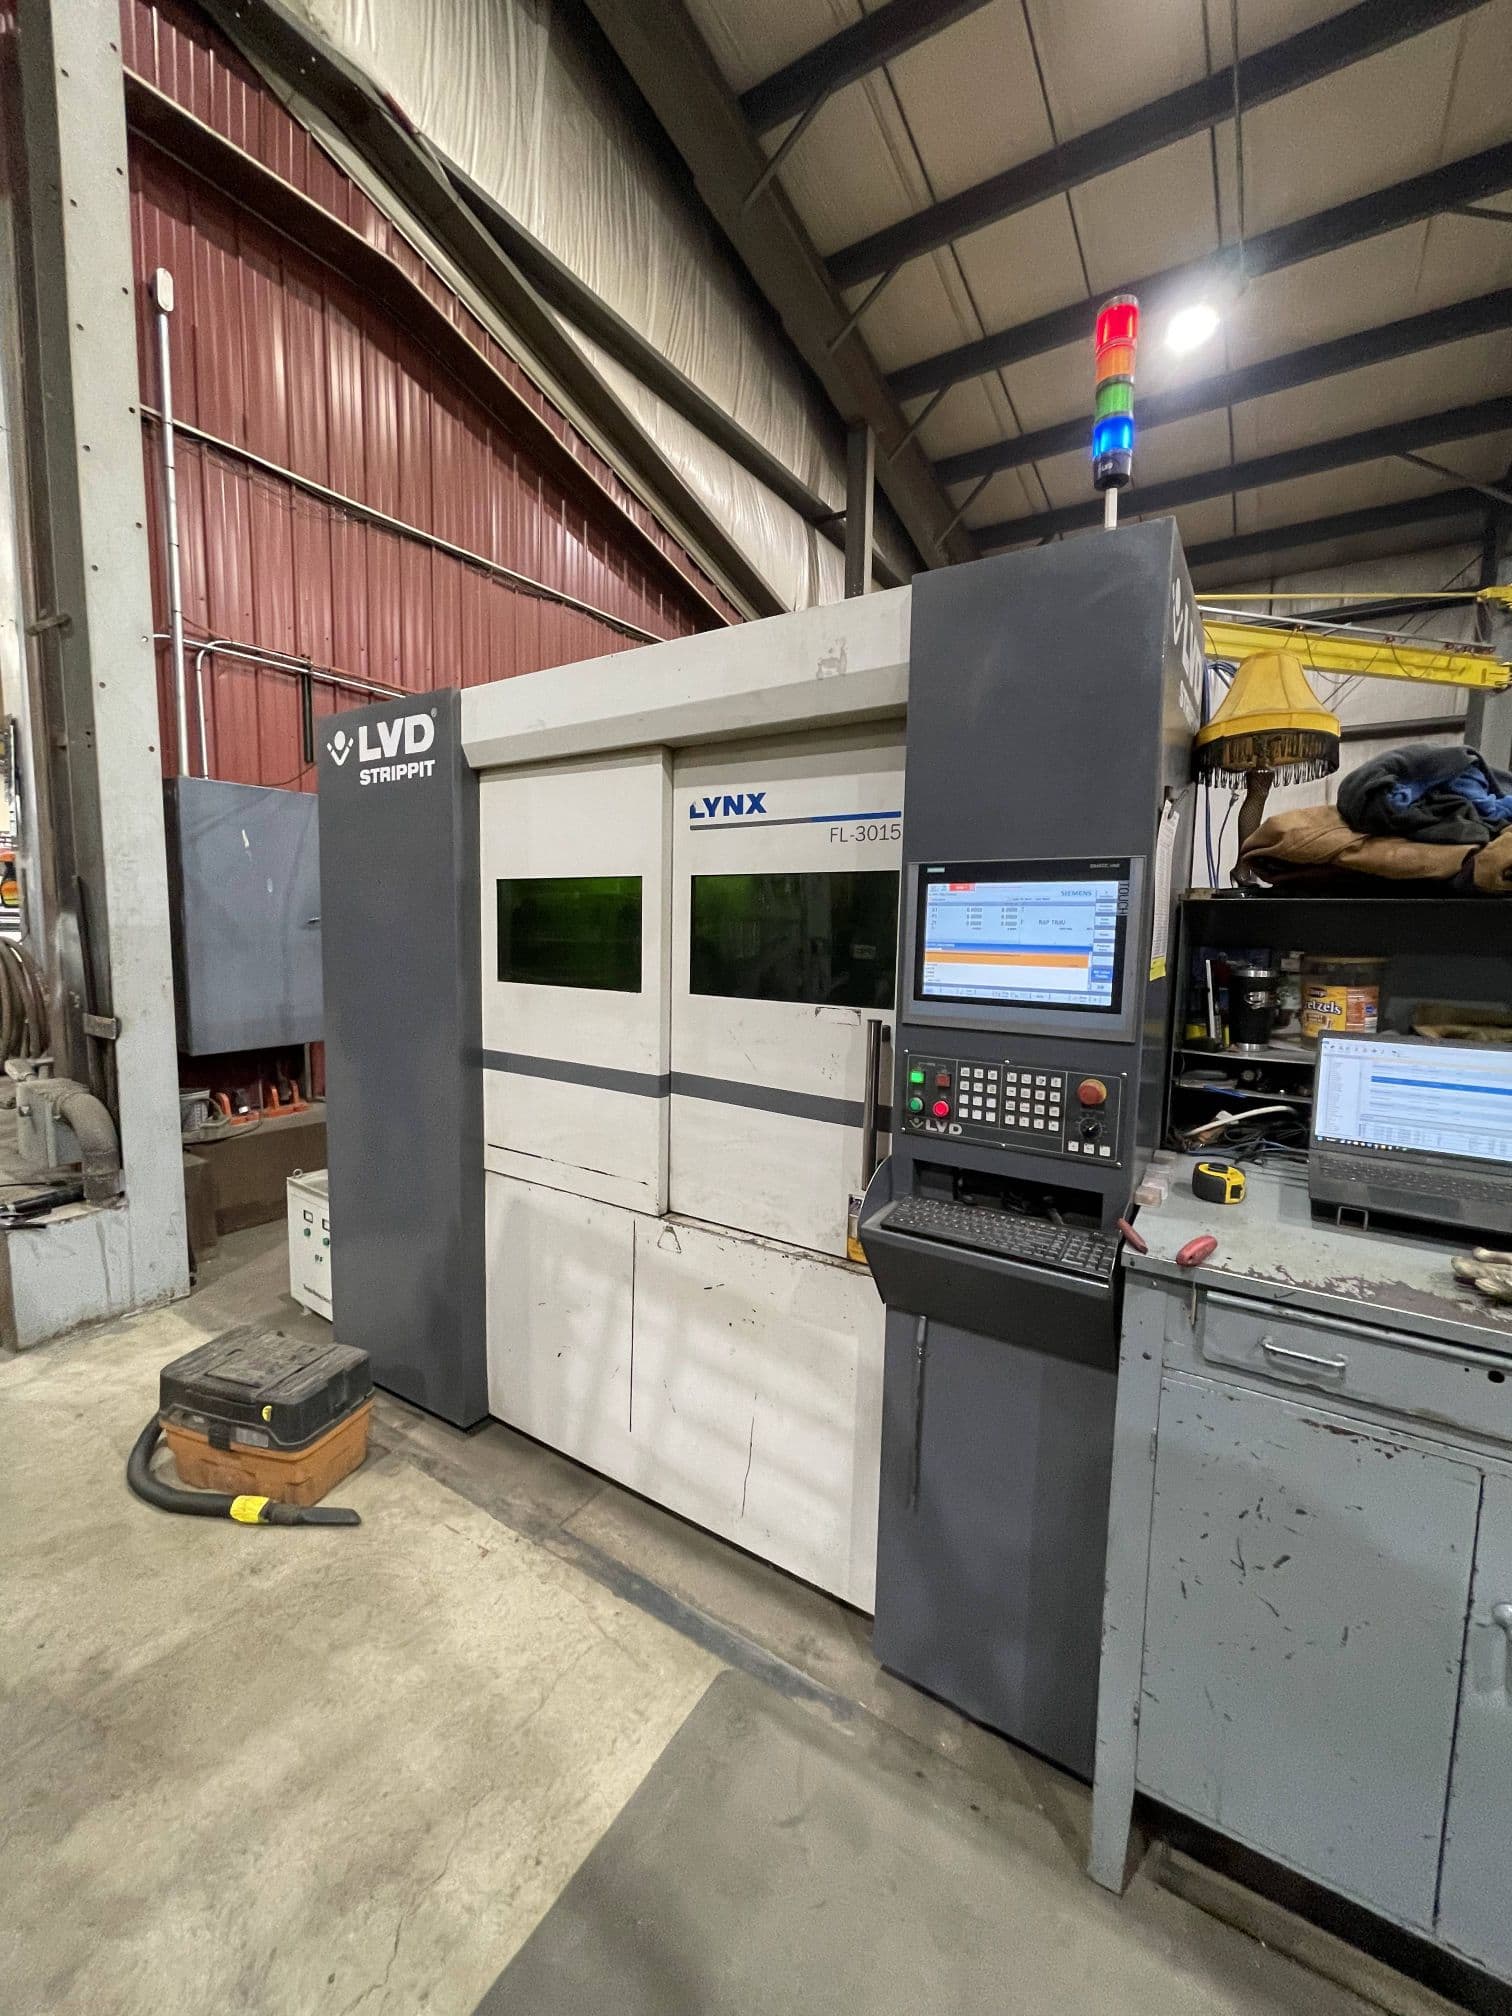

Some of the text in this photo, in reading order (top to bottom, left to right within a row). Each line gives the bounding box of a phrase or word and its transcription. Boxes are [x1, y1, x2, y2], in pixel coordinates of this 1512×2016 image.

[359, 714, 435, 762] LVD
[360, 760, 435, 786] STRIPPIT
[689, 792, 768, 819] LYNX
[830, 823, 901, 843] FL-3015
[1117, 882, 1130, 915] TOUCH
[925, 1119, 963, 1135] LVD
